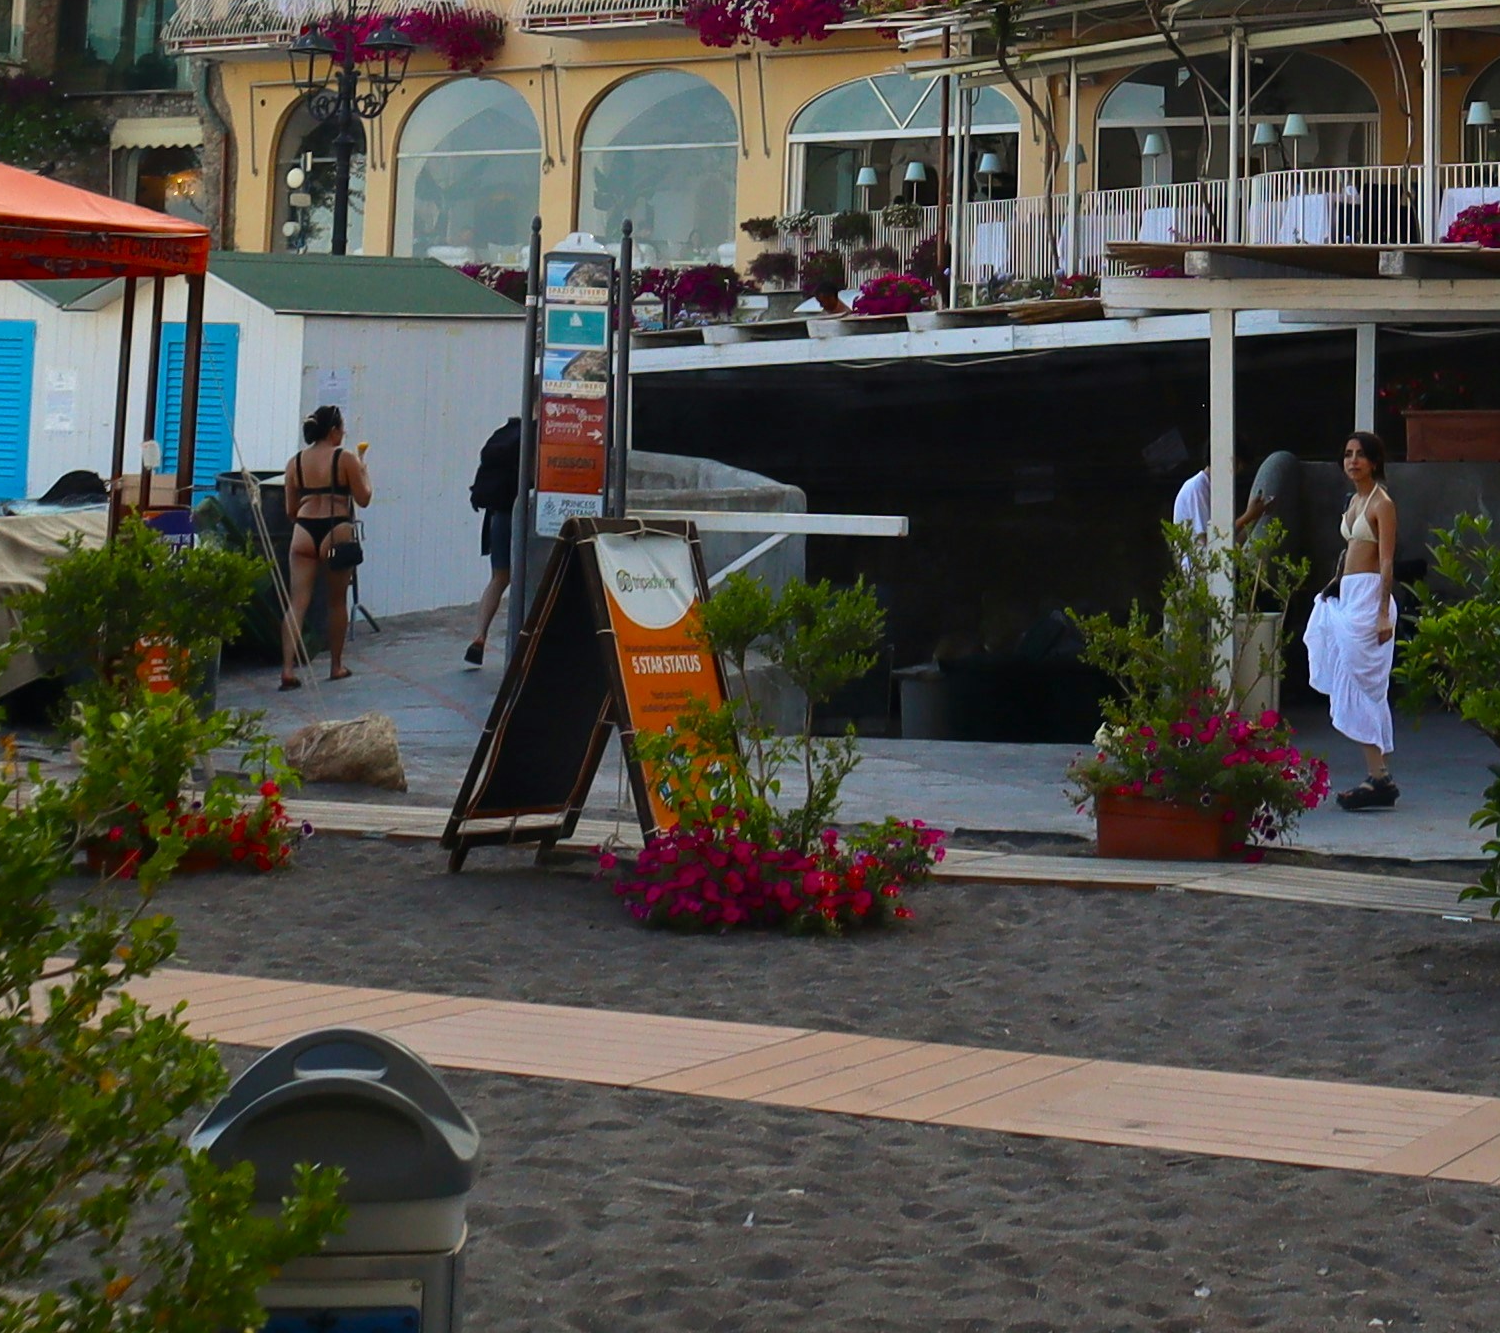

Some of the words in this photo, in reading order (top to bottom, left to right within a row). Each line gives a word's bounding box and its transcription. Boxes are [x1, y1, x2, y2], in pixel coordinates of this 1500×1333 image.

[129, 236, 191, 263] CRUISES
[548, 287, 575, 295] SPAZIO
[580, 288, 607, 296] LIBERO
[545, 380, 572, 389] SPAZIO
[576, 381, 604, 390] LIBERO
[560, 499, 598, 510] PRINCESS
[632, 656, 641, 674] 5
[641, 655, 664, 674] STAR
[664, 653, 702, 674] STATUS
